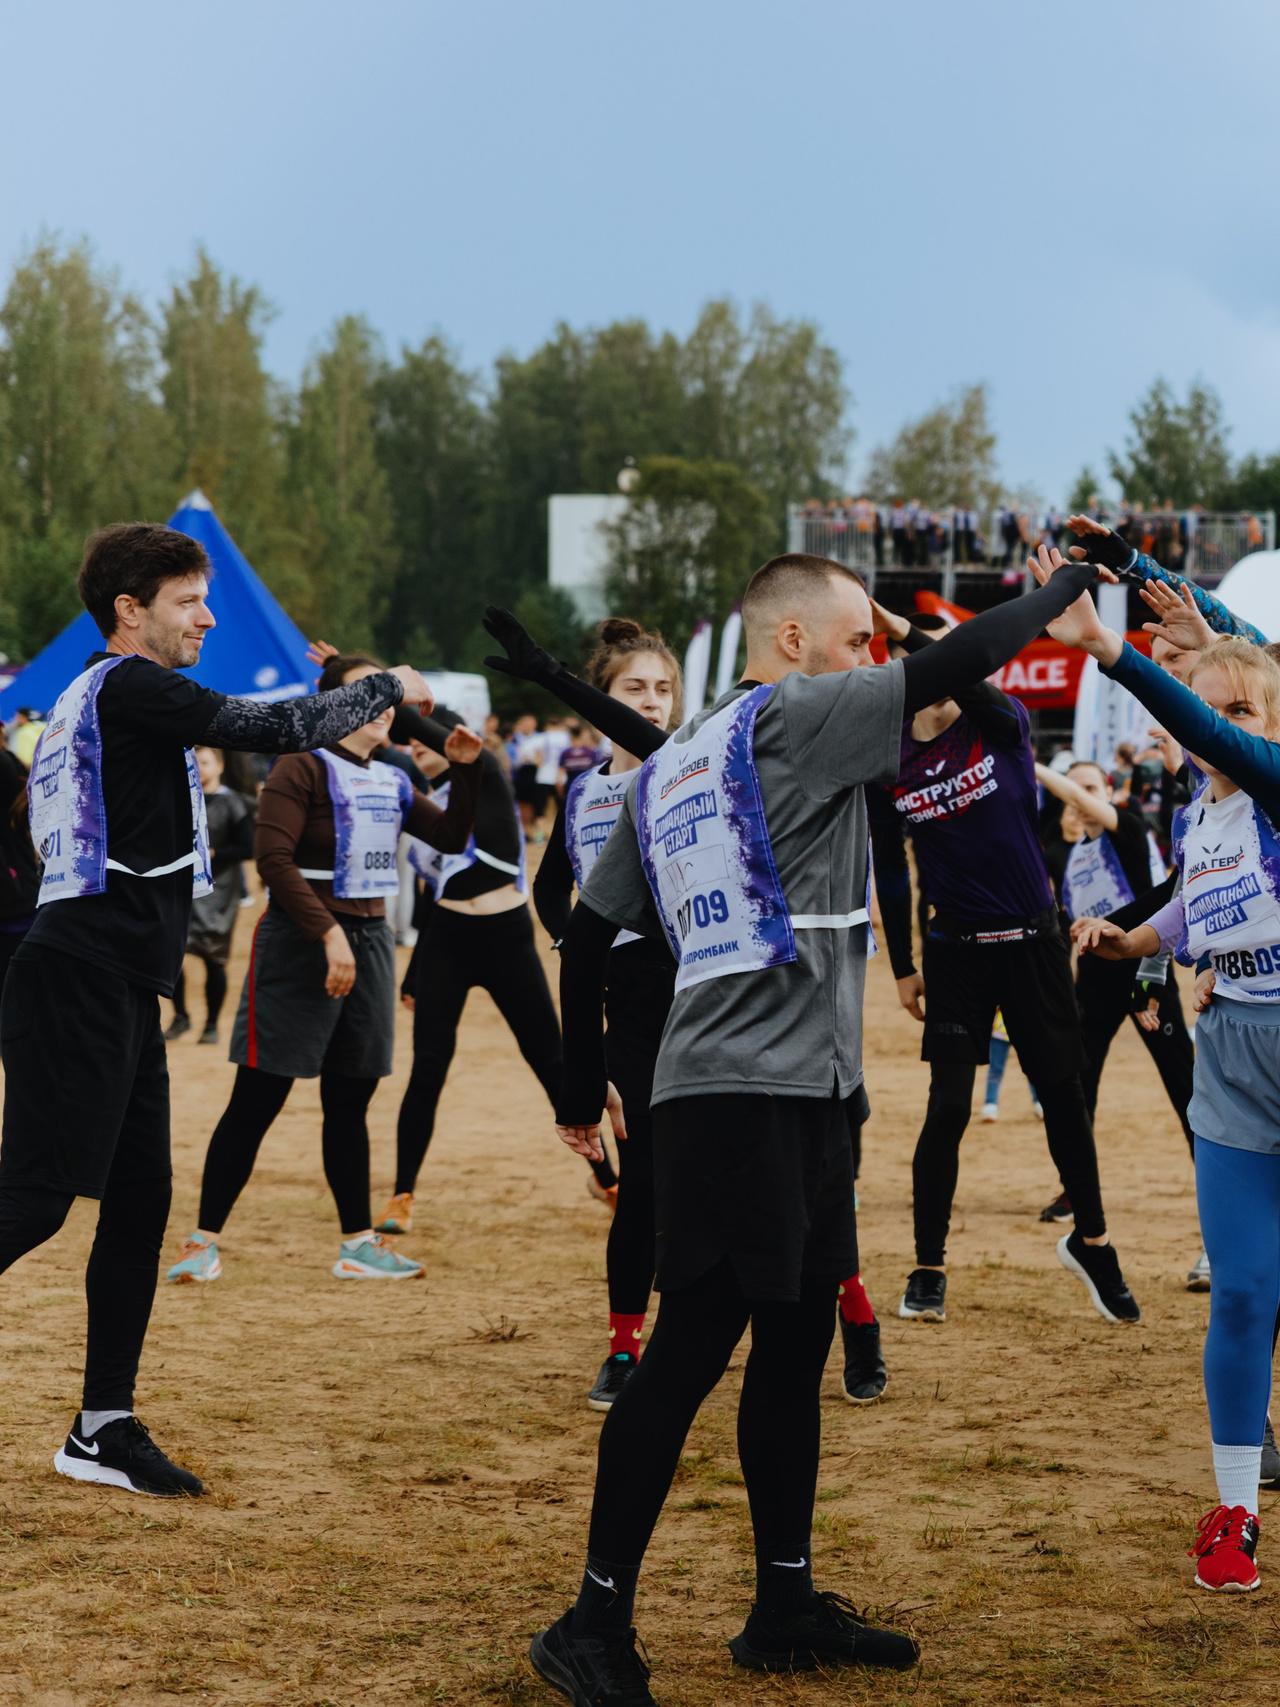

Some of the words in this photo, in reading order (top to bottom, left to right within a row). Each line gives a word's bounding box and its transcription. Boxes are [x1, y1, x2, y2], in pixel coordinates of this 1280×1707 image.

[947, 779, 998, 811] ГЕРОЕВ
[665, 825, 694, 855] СТАРТ
[1189, 873, 1259, 923] КОМАНДНЫЙ
[1206, 905, 1243, 932] СТАРТ
